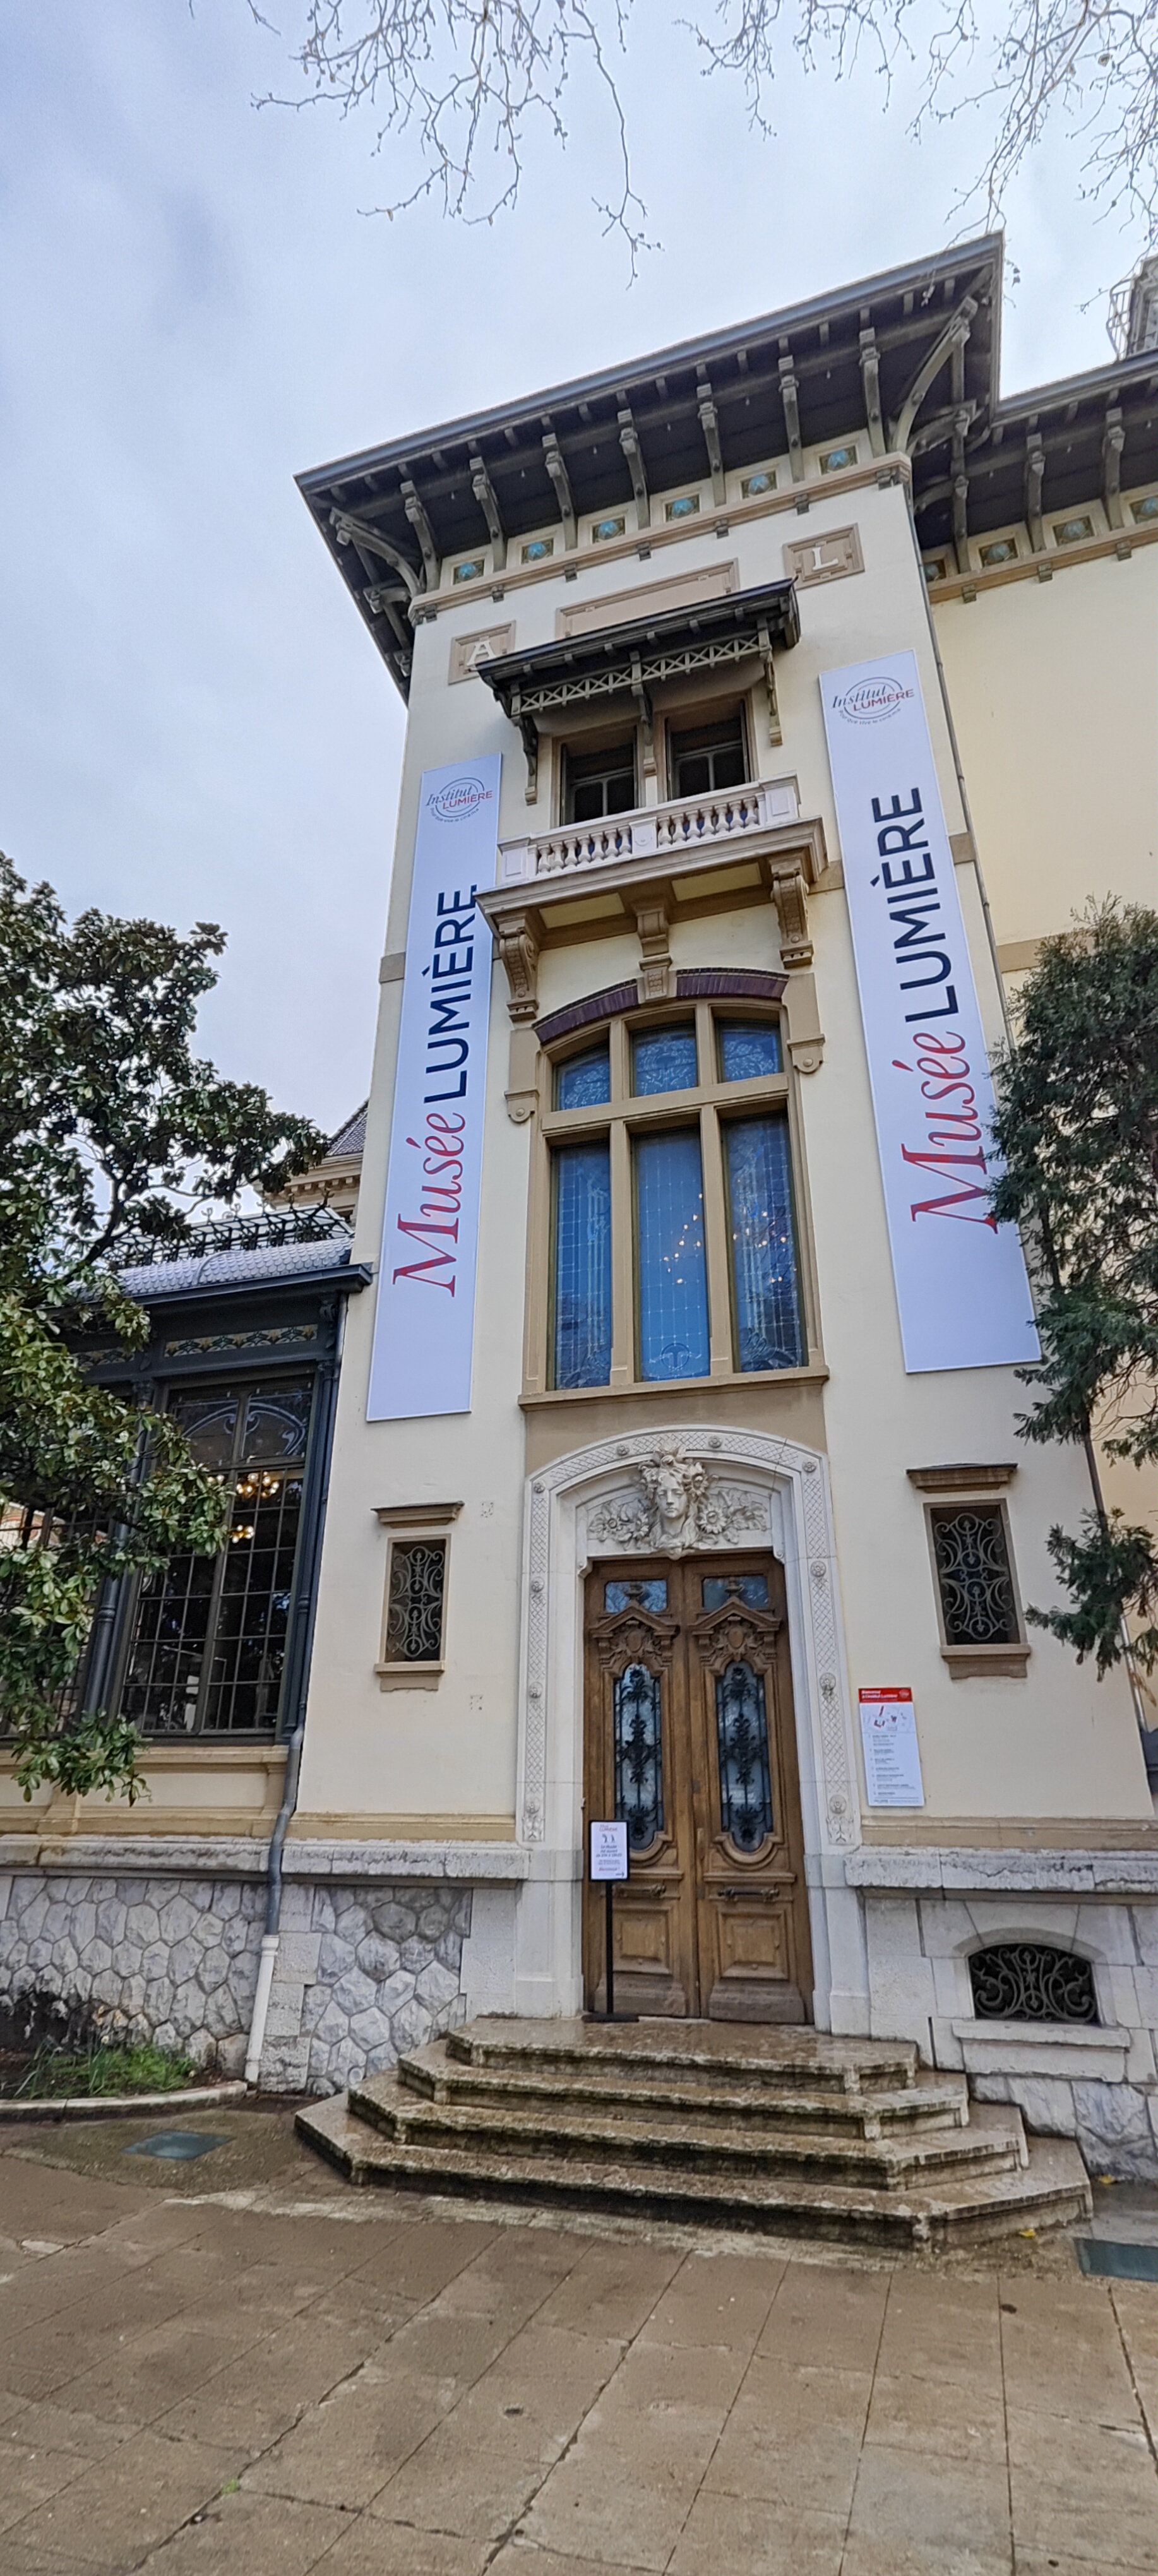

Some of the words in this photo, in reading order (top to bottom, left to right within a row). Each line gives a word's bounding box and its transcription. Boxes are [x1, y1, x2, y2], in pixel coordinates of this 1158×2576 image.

[812, 547, 839, 571] L
[467, 640, 498, 667] A
[832, 685, 886, 708] Institut
[426, 785, 472, 806] Institut
[870, 787, 959, 1023] LUMIÈRE
[421, 884, 477, 1104] LUMIÈRE
[892, 1031, 998, 1234] Musée
[393, 1112, 466, 1297] Musée
